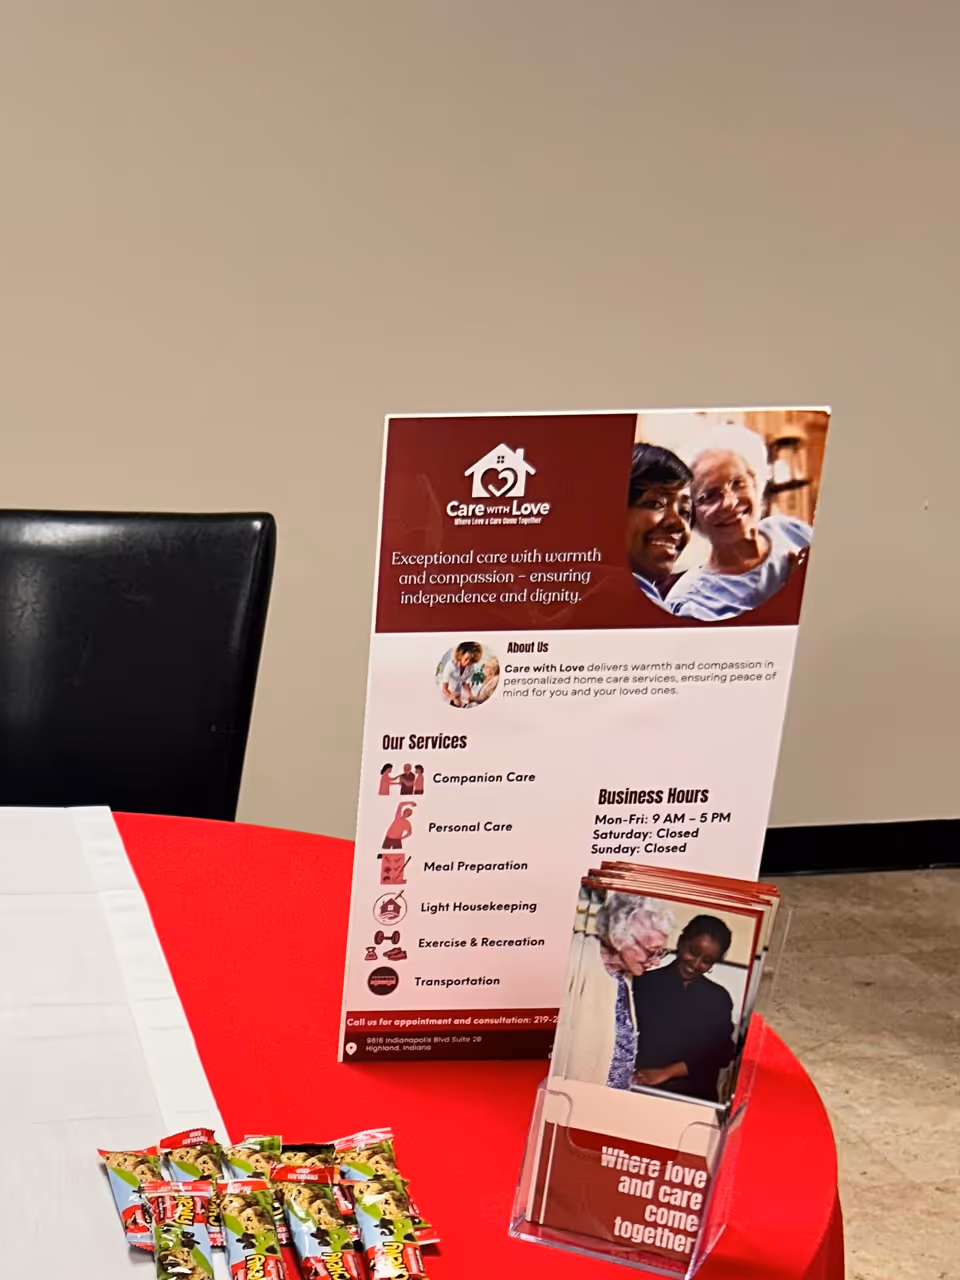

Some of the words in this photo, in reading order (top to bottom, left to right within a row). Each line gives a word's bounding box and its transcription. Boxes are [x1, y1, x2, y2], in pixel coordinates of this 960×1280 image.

[446, 501, 485, 517] Care
[487, 506, 510, 514] WITH
[512, 500, 550, 515] Love
[391, 550, 473, 568] Exceptional
[476, 553, 508, 564] care
[511, 549, 541, 563] with
[545, 548, 601, 563] warmth
[399, 571, 426, 585] and
[429, 571, 514, 587] compassion
[529, 569, 591, 585] ensuring
[400, 590, 497, 607] independence
[500, 589, 527, 603] and
[529, 588, 582, 604] dignity.
[507, 642, 535, 654] About
[537, 642, 549, 653] Us
[504, 664, 530, 673] Care
[533, 664, 557, 672] with
[559, 663, 585, 672] Love
[587, 663, 628, 672] delivers
[631, 661, 672, 671] warmth
[674, 661, 695, 670] and
[697, 660, 762, 673] compassion
[764, 660, 774, 669] in
[503, 676, 570, 687] personalized
[573, 675, 603, 684] home
[605, 676, 629, 684] care
[632, 674, 678, 684] services,
[681, 673, 727, 684] ensuring
[729, 673, 763, 683] peace
[765, 672, 777, 681] of
[503, 688, 529, 698] mind
[532, 688, 547, 697] for
[549, 689, 569, 699] you
[571, 687, 591, 696] and
[593, 688, 618, 698] your
[619, 686, 648, 696] loved
[650, 687, 678, 695] ones.
[382, 734, 405, 750] Our
[409, 733, 467, 749] Services
[433, 772, 502, 786] Companion
[507, 772, 536, 782] Care
[598, 788, 664, 805] Business
[667, 787, 709, 804] Hours
[594, 814, 648, 825] Mon-Fri:
[652, 814, 660, 824] 9
[663, 813, 685, 824] AM
[699, 813, 708, 823] 5
[711, 812, 731, 823] PM
[428, 822, 480, 833] Personal
[484, 822, 512, 832] Care
[592, 829, 652, 842] Saturday:
[656, 828, 699, 838] Closed
[591, 844, 640, 856] Sunday:
[644, 842, 687, 853] Closed
[423, 861, 454, 872] Meal
[457, 860, 528, 873] Preparation
[421, 902, 449, 915] Light
[453, 901, 537, 914] Housekeeping
[418, 938, 467, 948] Exercise
[470, 938, 478, 947] &
[481, 937, 545, 947] Recreation
[415, 976, 500, 988] Transportation
[347, 1018, 366, 1026] Call
[379, 1018, 392, 1026] for
[394, 1017, 452, 1027] appointment
[453, 1017, 471, 1025] and
[473, 1016, 531, 1025] consultation:
[601, 1146, 661, 1178] Where
[665, 1161, 707, 1189] love
[618, 1176, 654, 1200] and
[659, 1185, 703, 1211] care
[645, 1205, 699, 1232] come
[614, 1216, 696, 1254] together
